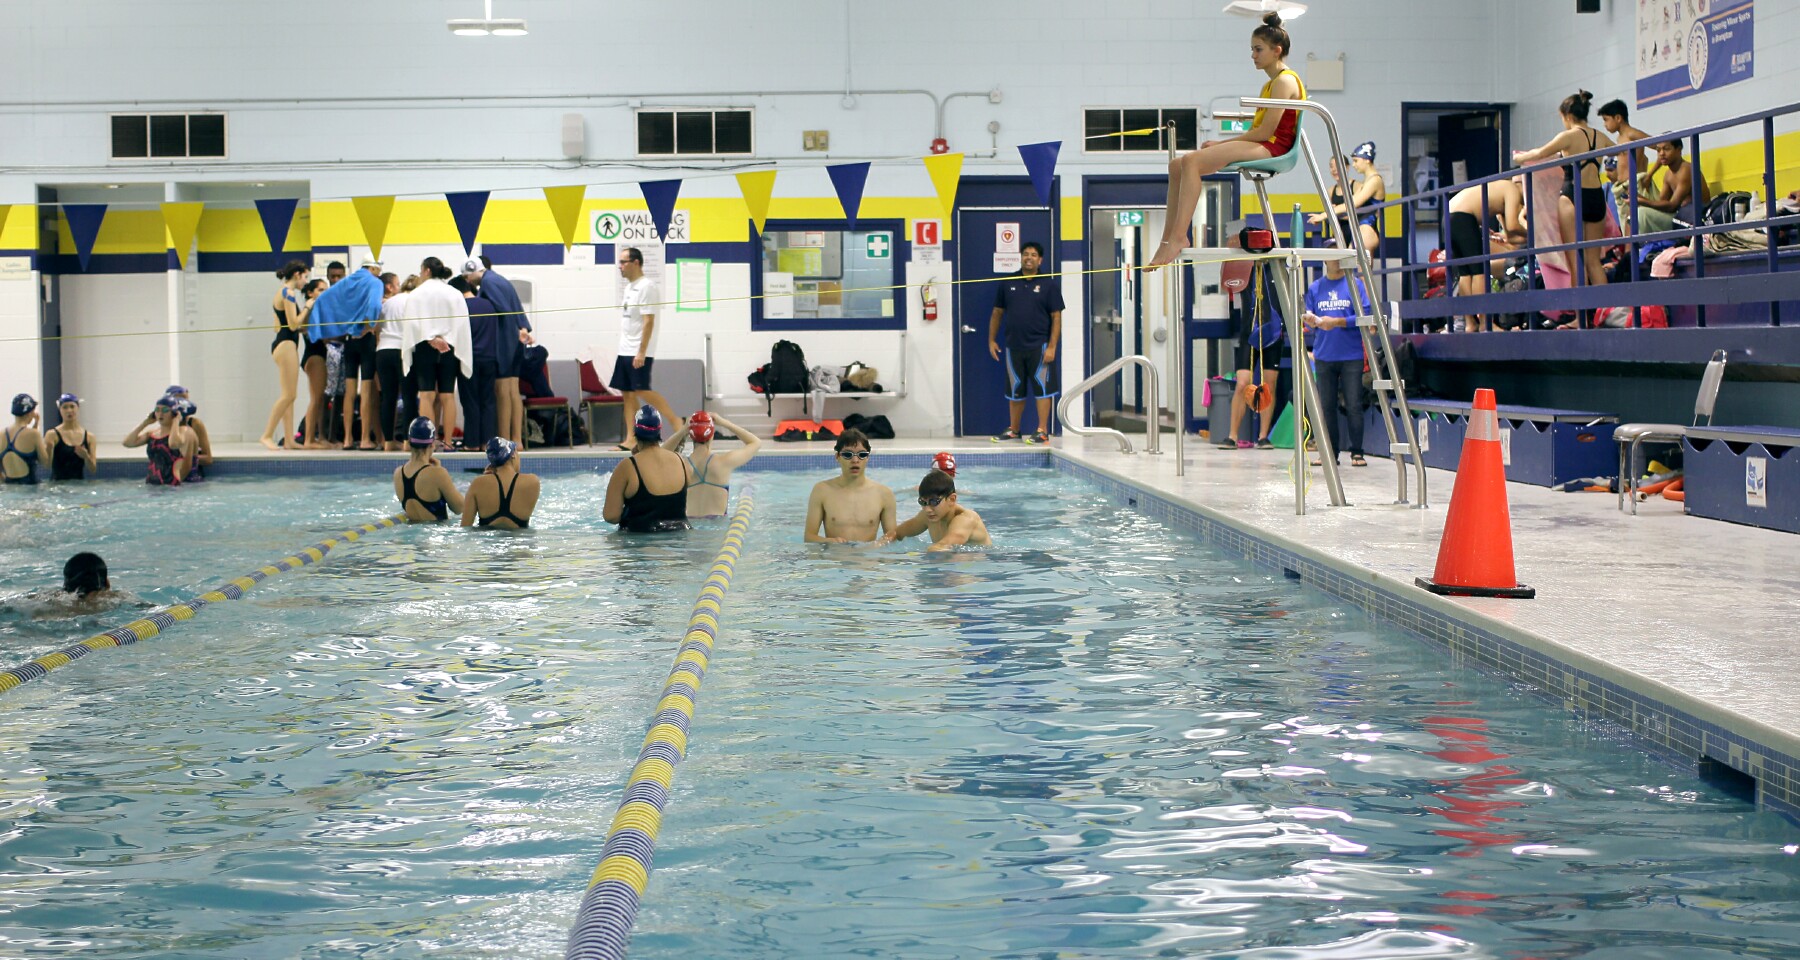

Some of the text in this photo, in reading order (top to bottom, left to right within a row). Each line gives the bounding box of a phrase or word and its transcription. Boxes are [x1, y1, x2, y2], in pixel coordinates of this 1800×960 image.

[623, 213, 684, 225] WALG
[623, 227, 685, 239] ON DCK
